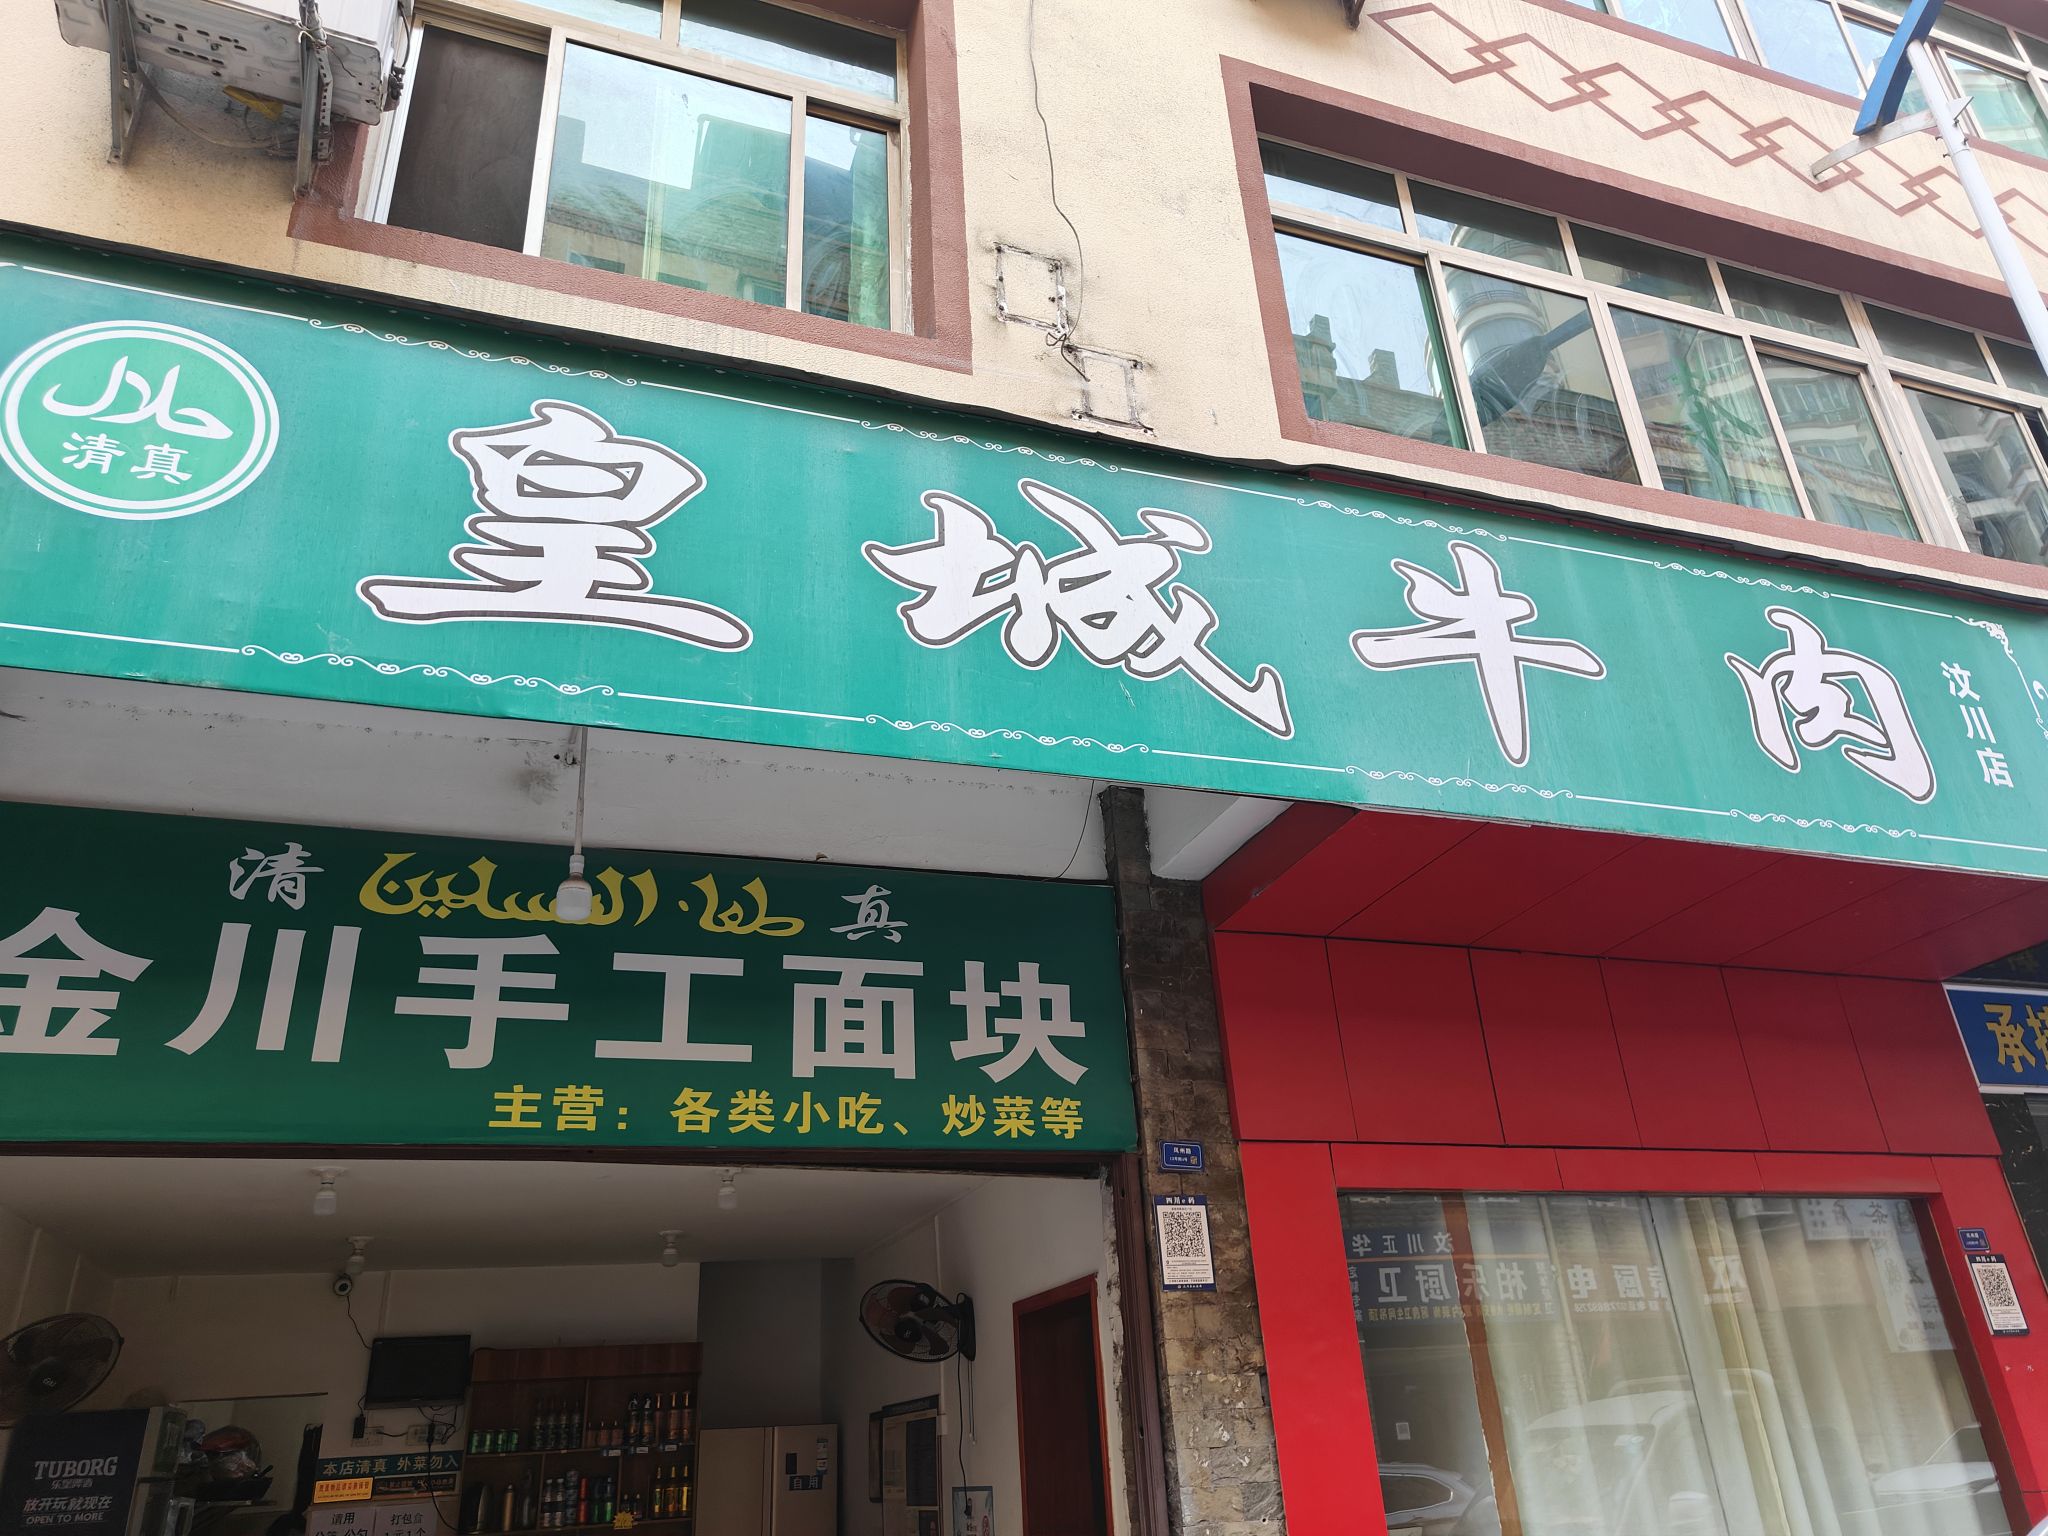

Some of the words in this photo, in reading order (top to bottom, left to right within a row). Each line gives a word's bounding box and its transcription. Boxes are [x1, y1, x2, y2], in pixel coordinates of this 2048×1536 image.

[42, 355, 234, 440] حلال
[62, 432, 193, 484] 清真
[355, 399, 1937, 805] 皇城牛肉
[1940, 661, 2014, 789] 汶川店
[228, 842, 325, 910] 清
[830, 884, 909, 943] 真
[0, 906, 1089, 1086] 金川手工面块
[34, 1456, 119, 1481] TUBORG
[322, 1458, 388, 1477] 本店清真
[396, 1454, 459, 1473] 外菜勿入
[26, 1513, 55, 1526] OPEN
[57, 1513, 73, 1524] TO
[74, 1511, 105, 1523] MORE
